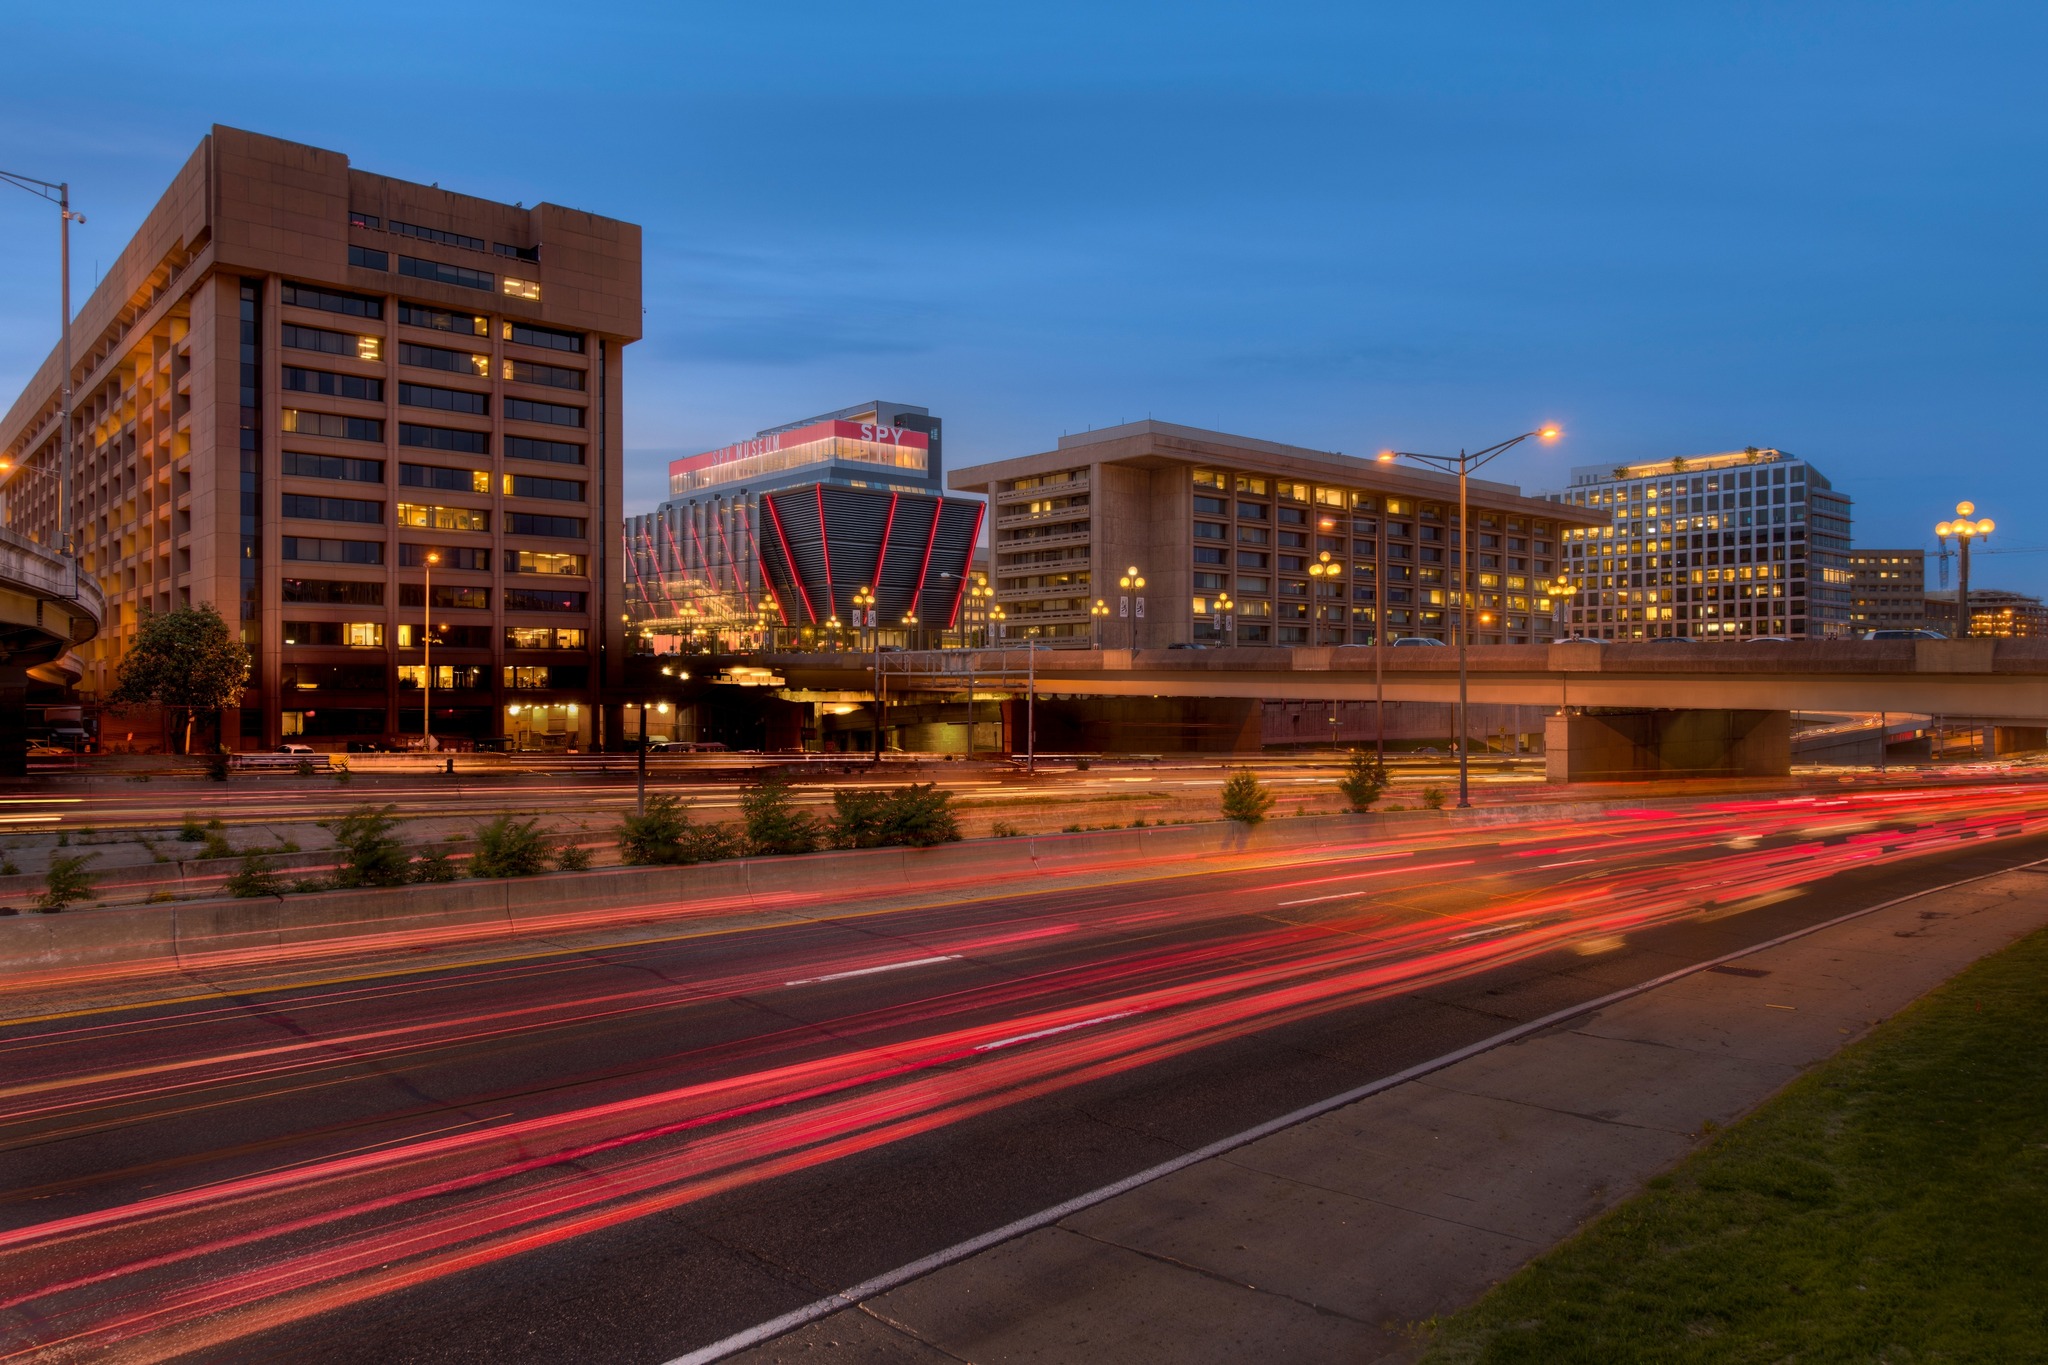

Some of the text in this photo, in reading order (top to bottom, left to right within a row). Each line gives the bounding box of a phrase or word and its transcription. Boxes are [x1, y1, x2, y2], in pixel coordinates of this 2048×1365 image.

[861, 424, 904, 446] SPY
[712, 434, 780, 466] SPY MUSEUM
